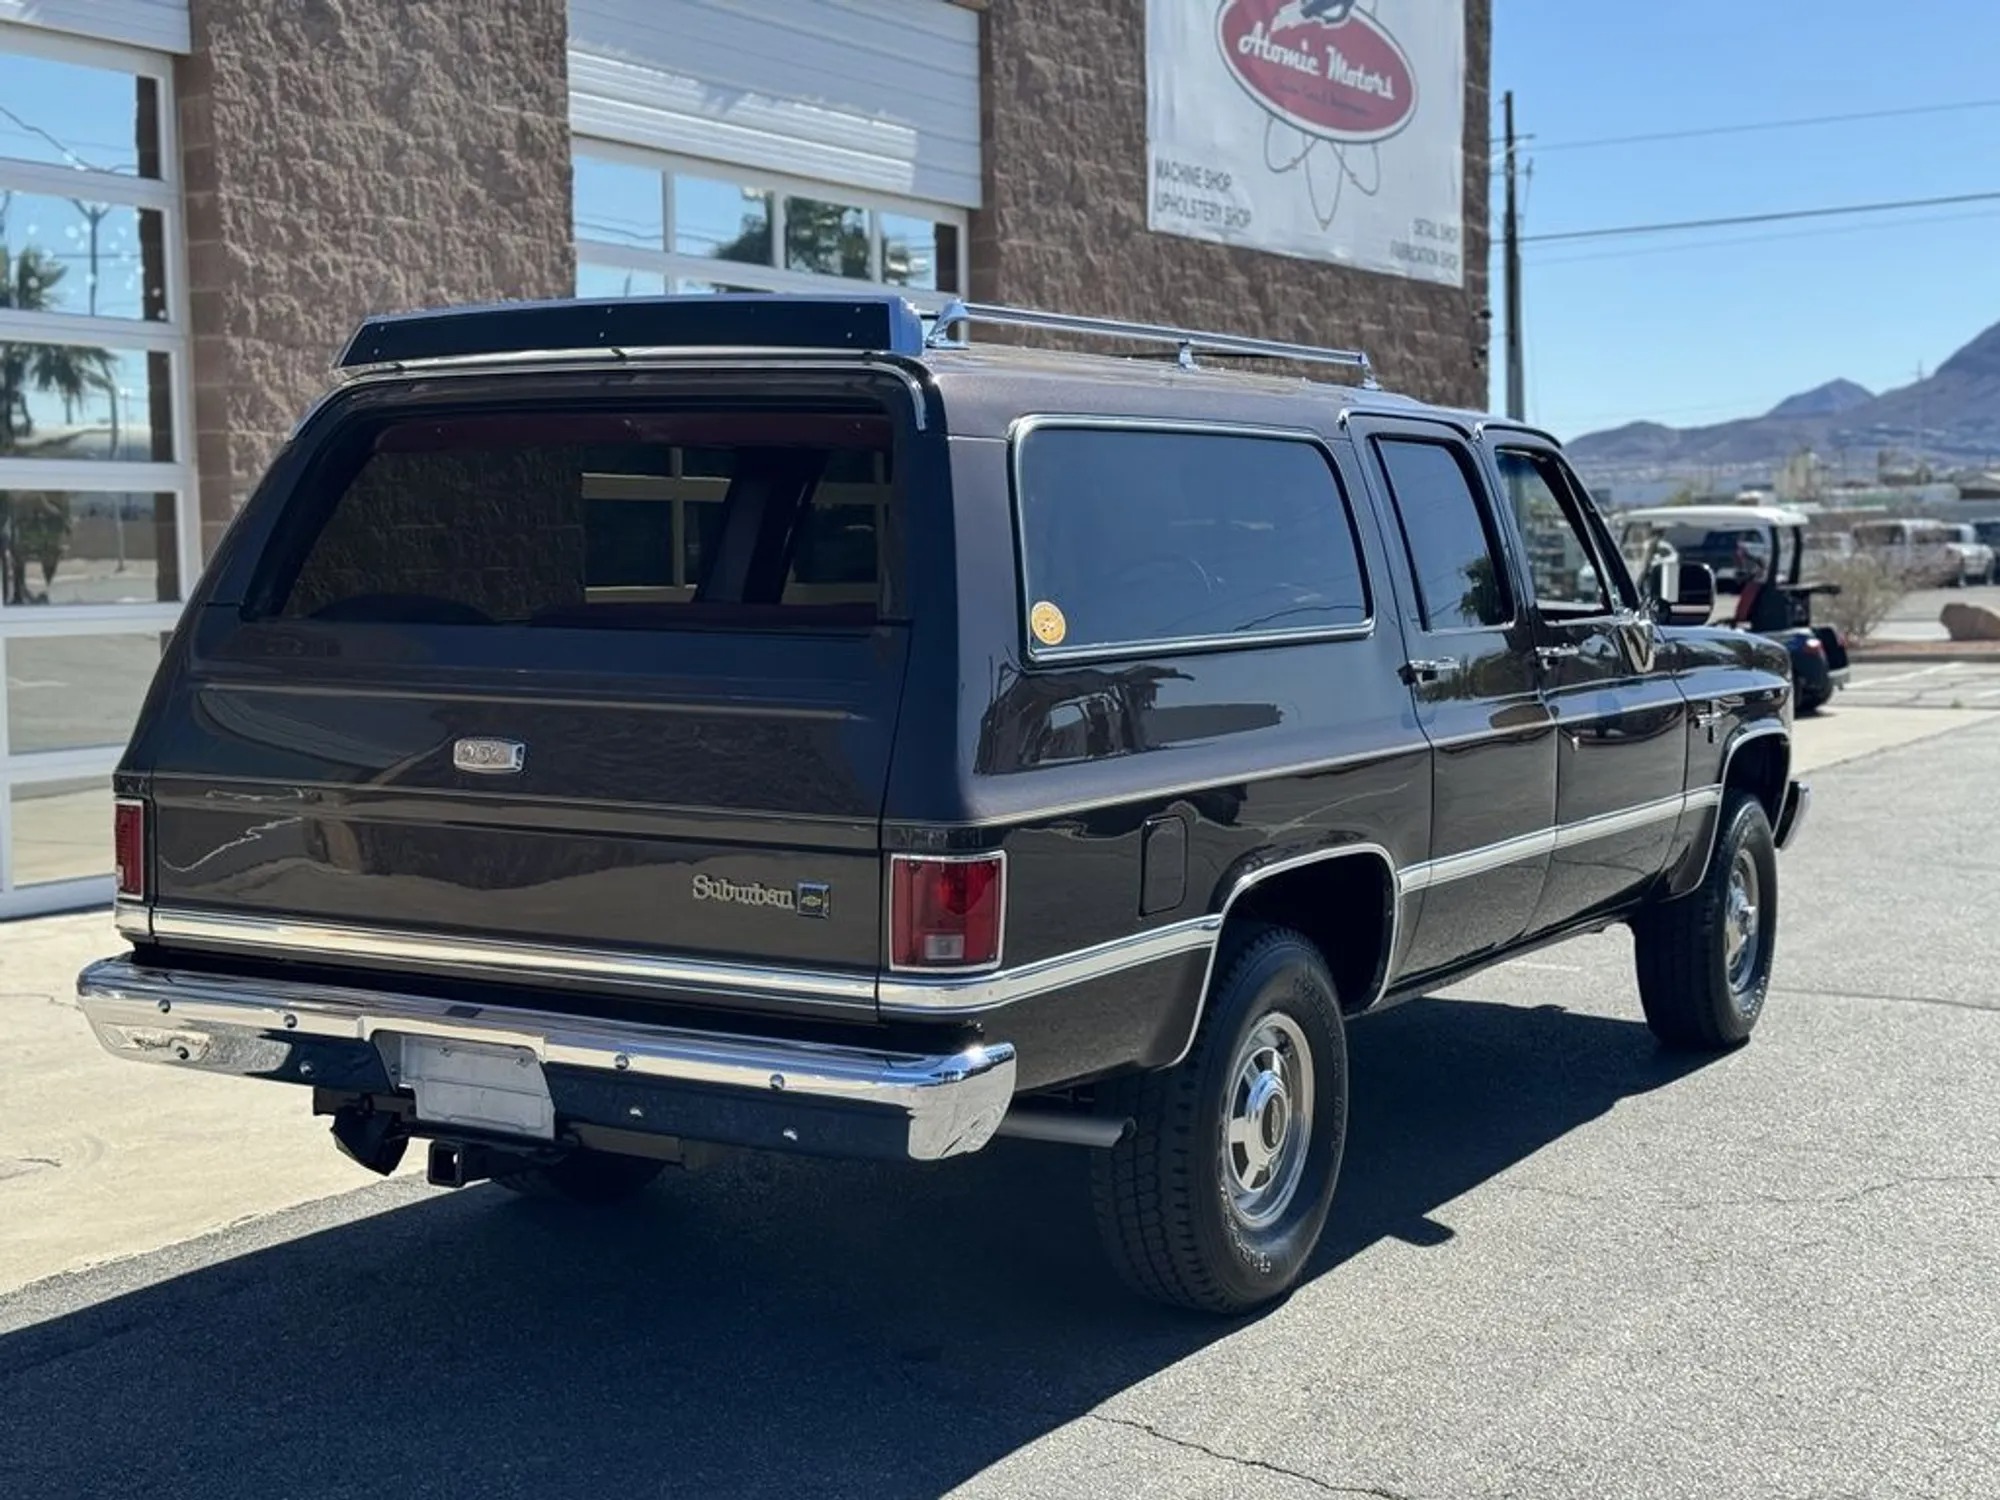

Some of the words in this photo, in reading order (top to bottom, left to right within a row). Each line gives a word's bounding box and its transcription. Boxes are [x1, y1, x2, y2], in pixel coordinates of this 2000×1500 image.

[1238, 21, 1320, 76] Atomic
[1326, 45, 1395, 100] Motors
[1155, 158, 1201, 188] MACHINE
[1204, 168, 1231, 193] SHOP
[1155, 191, 1222, 222] UPHOLSTERY
[1223, 205, 1251, 228] SHOP
[692, 874, 796, 911] Suburban
